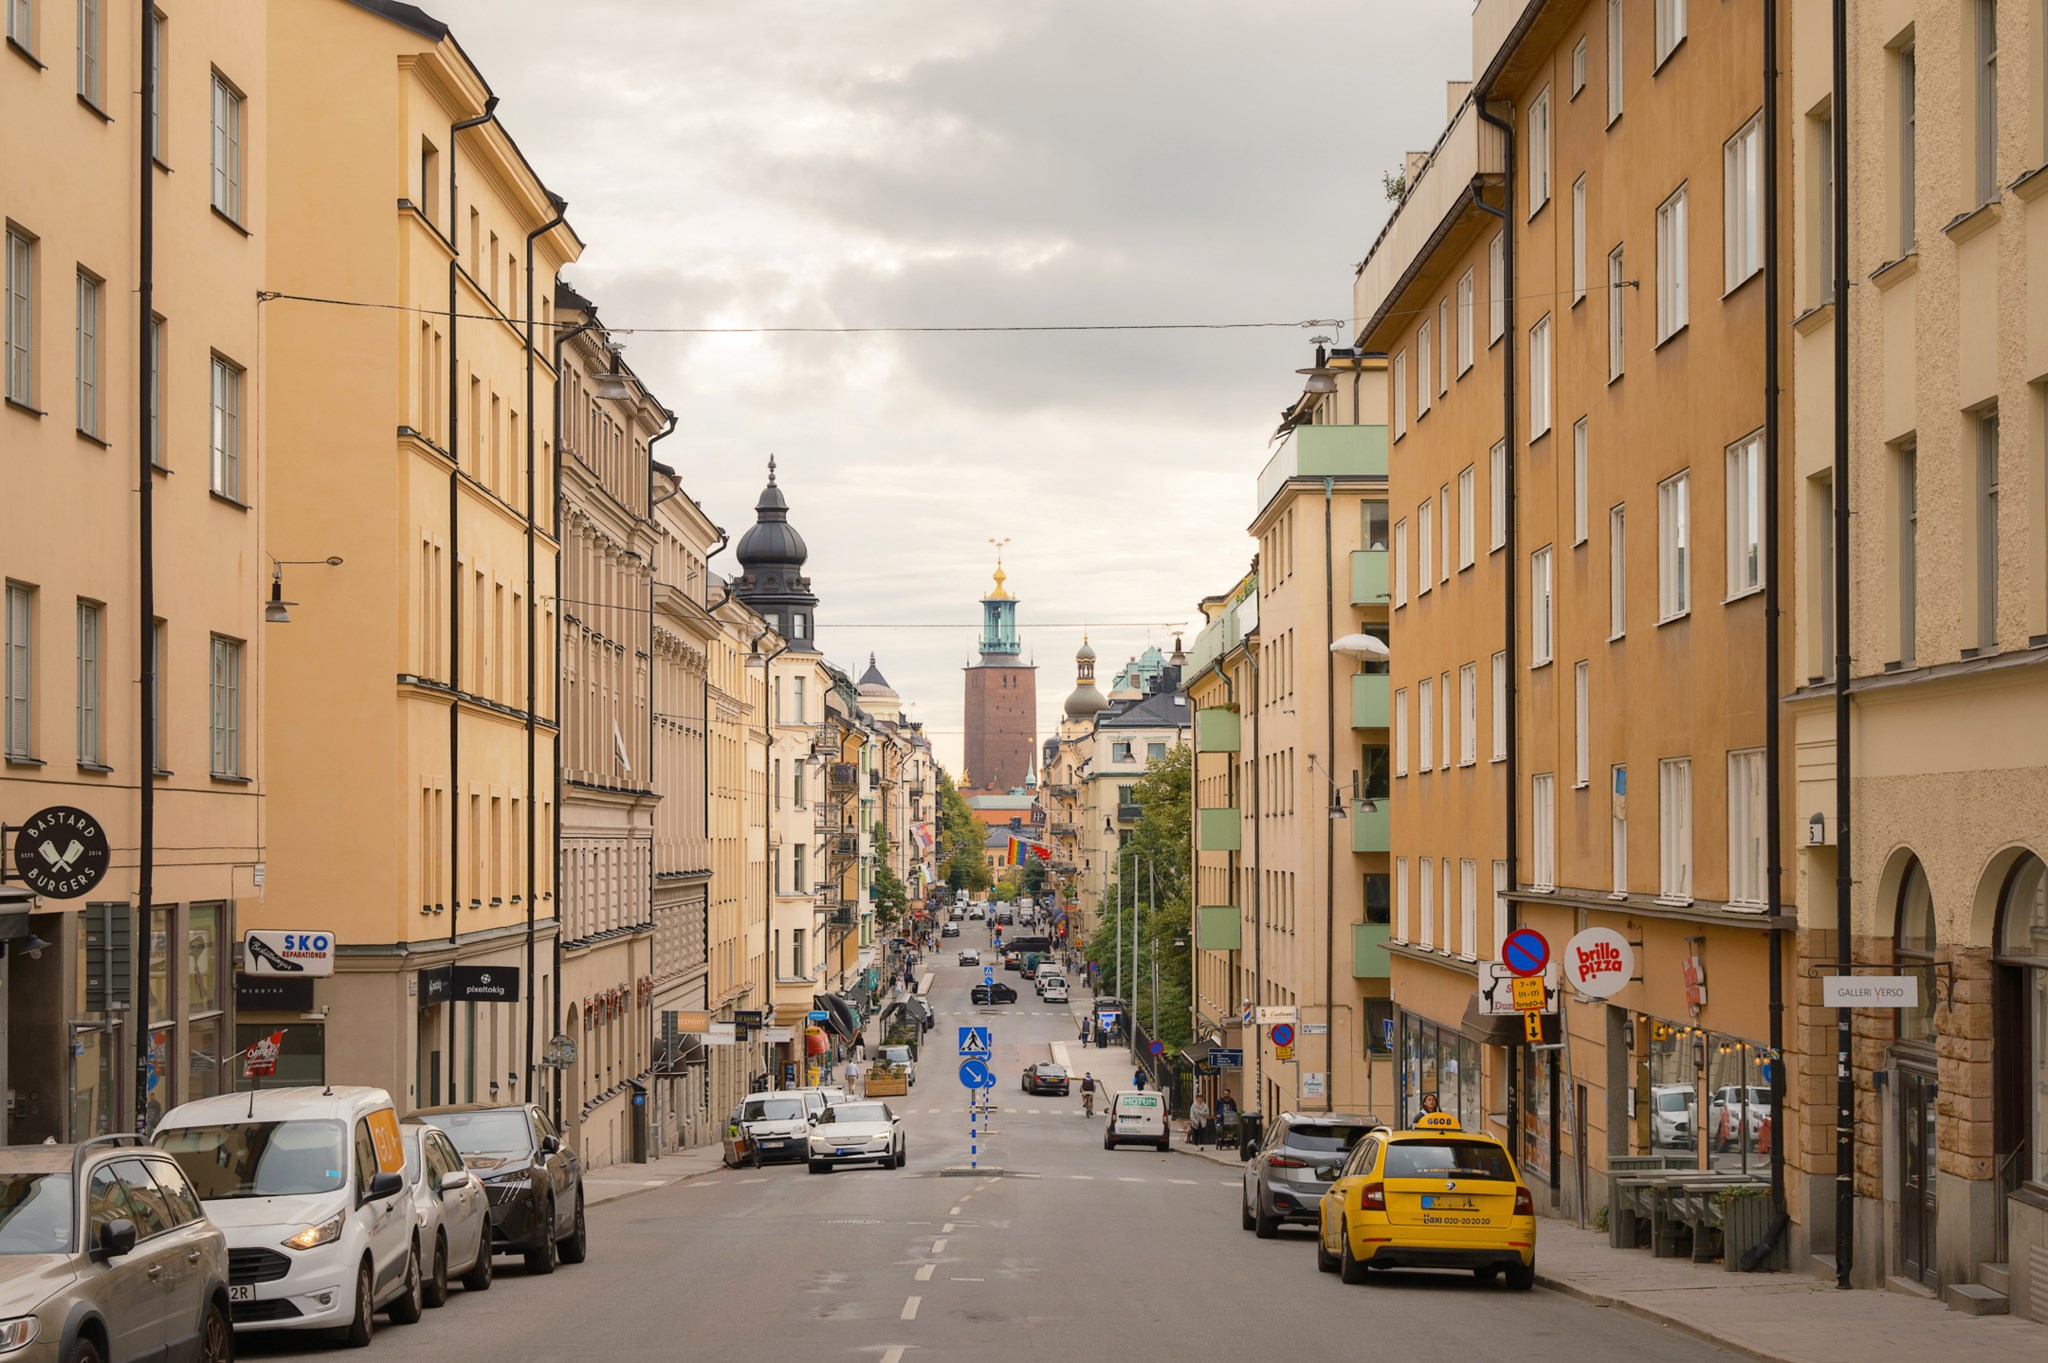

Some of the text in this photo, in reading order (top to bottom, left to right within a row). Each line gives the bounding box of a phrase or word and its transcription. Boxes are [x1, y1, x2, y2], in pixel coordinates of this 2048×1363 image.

[27, 812, 95, 838] BASTARD
[27, 867, 96, 892] BURGERS
[284, 934, 328, 951] SKO
[281, 951, 327, 959] REPARATIONER
[1576, 942, 1620, 964] brillo
[1578, 960, 1622, 983] pizza
[466, 985, 505, 995] pixeltokig
[1838, 987, 1904, 998] GALLERI VERSO
[1124, 1098, 1156, 1106] MOTUM
[1444, 1217, 1471, 1225] 020-20
[230, 1287, 248, 1300] 2R
